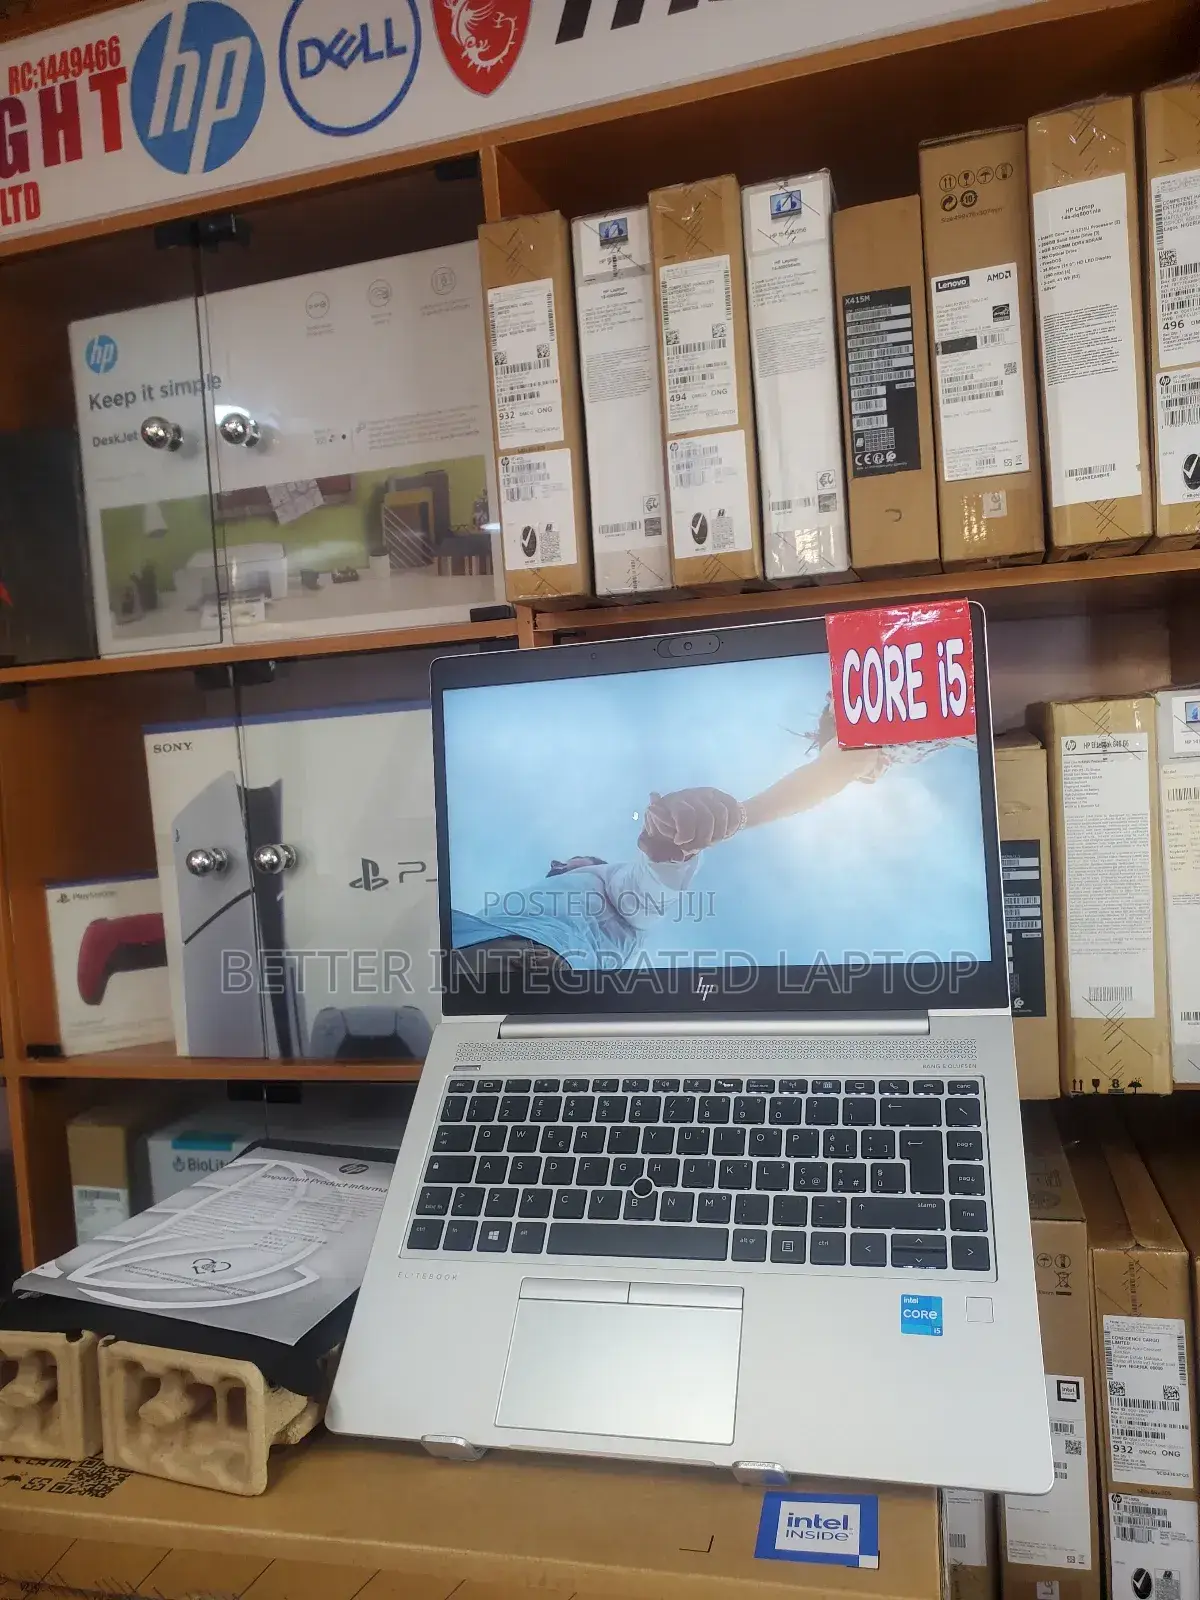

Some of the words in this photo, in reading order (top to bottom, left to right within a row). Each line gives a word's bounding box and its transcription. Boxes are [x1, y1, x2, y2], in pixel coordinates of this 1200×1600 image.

[298, 17, 408, 79] DELL
[8, 34, 121, 95] RC:1449466
[1074, 203, 1095, 212] Laptop
[937, 279, 968, 290] Lenovo
[986, 272, 1005, 283] AMD
[844, 295, 871, 305] X415M
[1162, 319, 1185, 331] 496
[89, 391, 137, 411] Keep
[141, 383, 154, 401] it
[160, 373, 222, 399] simple
[669, 392, 687, 402] 494
[710, 388, 728, 396] ONG
[499, 410, 515, 421] 932
[537, 405, 553, 414] ONG
[92, 430, 139, 448] DeskJet
[842, 642, 928, 725] CORE
[937, 637, 967, 719] i5
[153, 741, 193, 754] SONY
[568, 1109, 574, 1117] 4
[483, 1130, 491, 1138] Q
[516, 1130, 526, 1138] W
[547, 1130, 555, 1138] E
[580, 1131, 588, 1139] R
[684, 1132, 692, 1140] U
[756, 1133, 765, 1142] O
[792, 1134, 800, 1142] P
[516, 1161, 524, 1169] S
[550, 1162, 558, 1170] D
[619, 1163, 627, 1171] G
[653, 1164, 661, 1172] H
[689, 1165, 695, 1173] J
[726, 1166, 734, 1174] K
[763, 1167, 769, 1175] L
[261, 1173, 309, 1183] Important
[310, 1178, 349, 1188] Product
[348, 1183, 389, 1193] Informa
[811, 1177, 821, 1185] @
[493, 1194, 500, 1202] Z
[561, 1195, 569, 1203] C
[596, 1196, 604, 1204] V
[667, 1198, 675, 1206] N
[705, 1199, 714, 1207] M
[397, 1271, 459, 1281] ELITEBOOK
[903, 1296, 919, 1304] intel
[1113, 1444, 1133, 1454] 932
[1161, 1449, 1181, 1458] ONG
[786, 1512, 849, 1531] intel
